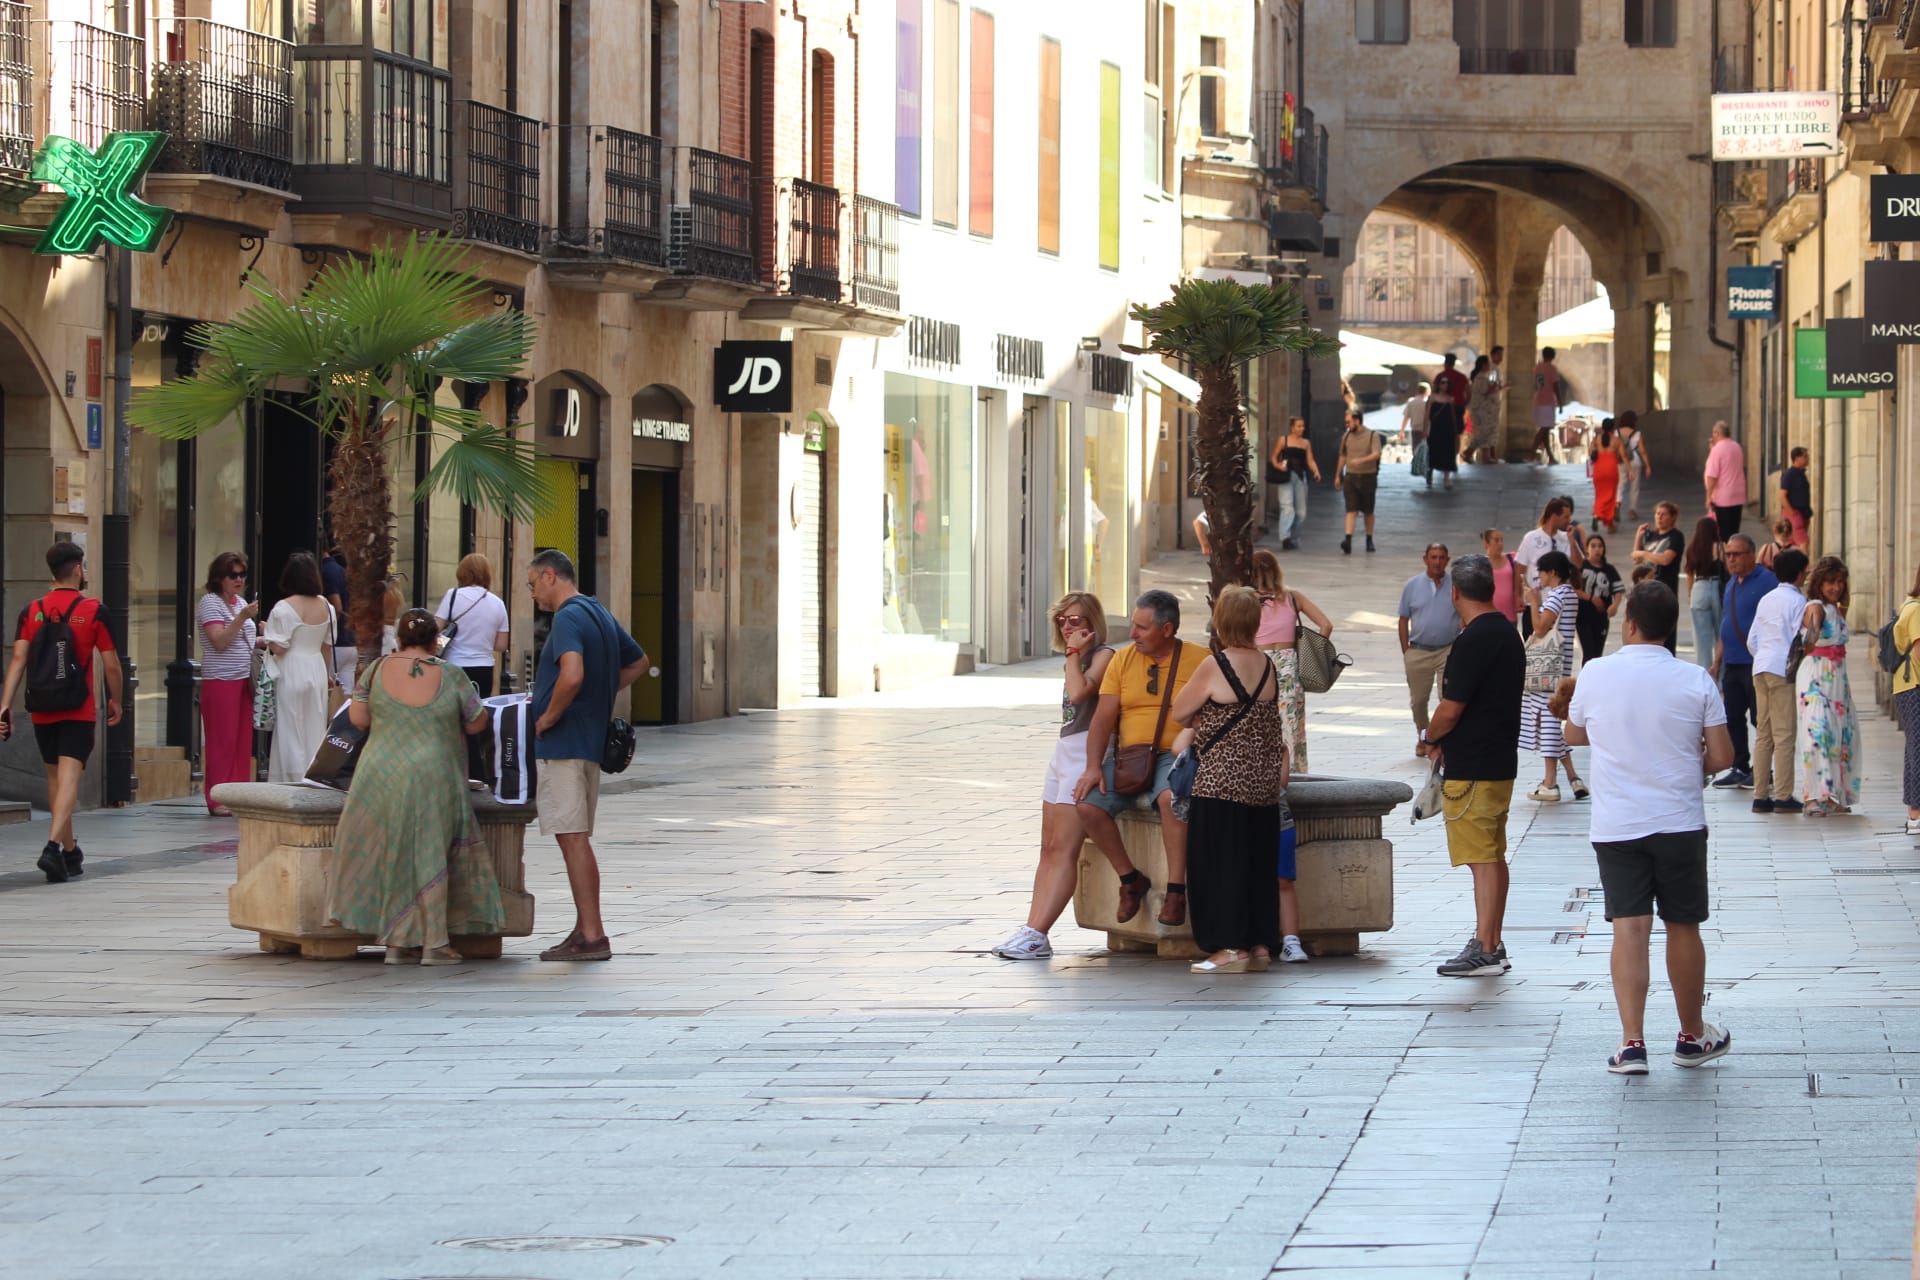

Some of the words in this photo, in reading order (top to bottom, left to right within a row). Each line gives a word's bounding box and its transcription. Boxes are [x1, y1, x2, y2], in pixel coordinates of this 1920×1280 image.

[1721, 101, 1788, 110] RESTAURANTE
[1797, 98, 1830, 108] CHINO
[1734, 112, 1771, 122] GRAN
[1775, 111, 1817, 121] MUNDO
[1721, 124, 1780, 136] BUFFET
[1785, 122, 1832, 134] LIBRE
[1728, 286, 1774, 299] Phone
[1728, 299, 1774, 311] House
[728, 357, 782, 395] JD
[1832, 371, 1894, 385] MANGO
[563, 388, 581, 437] JD
[641, 418, 656, 439] KING
[662, 420, 690, 442] TRAINERS
